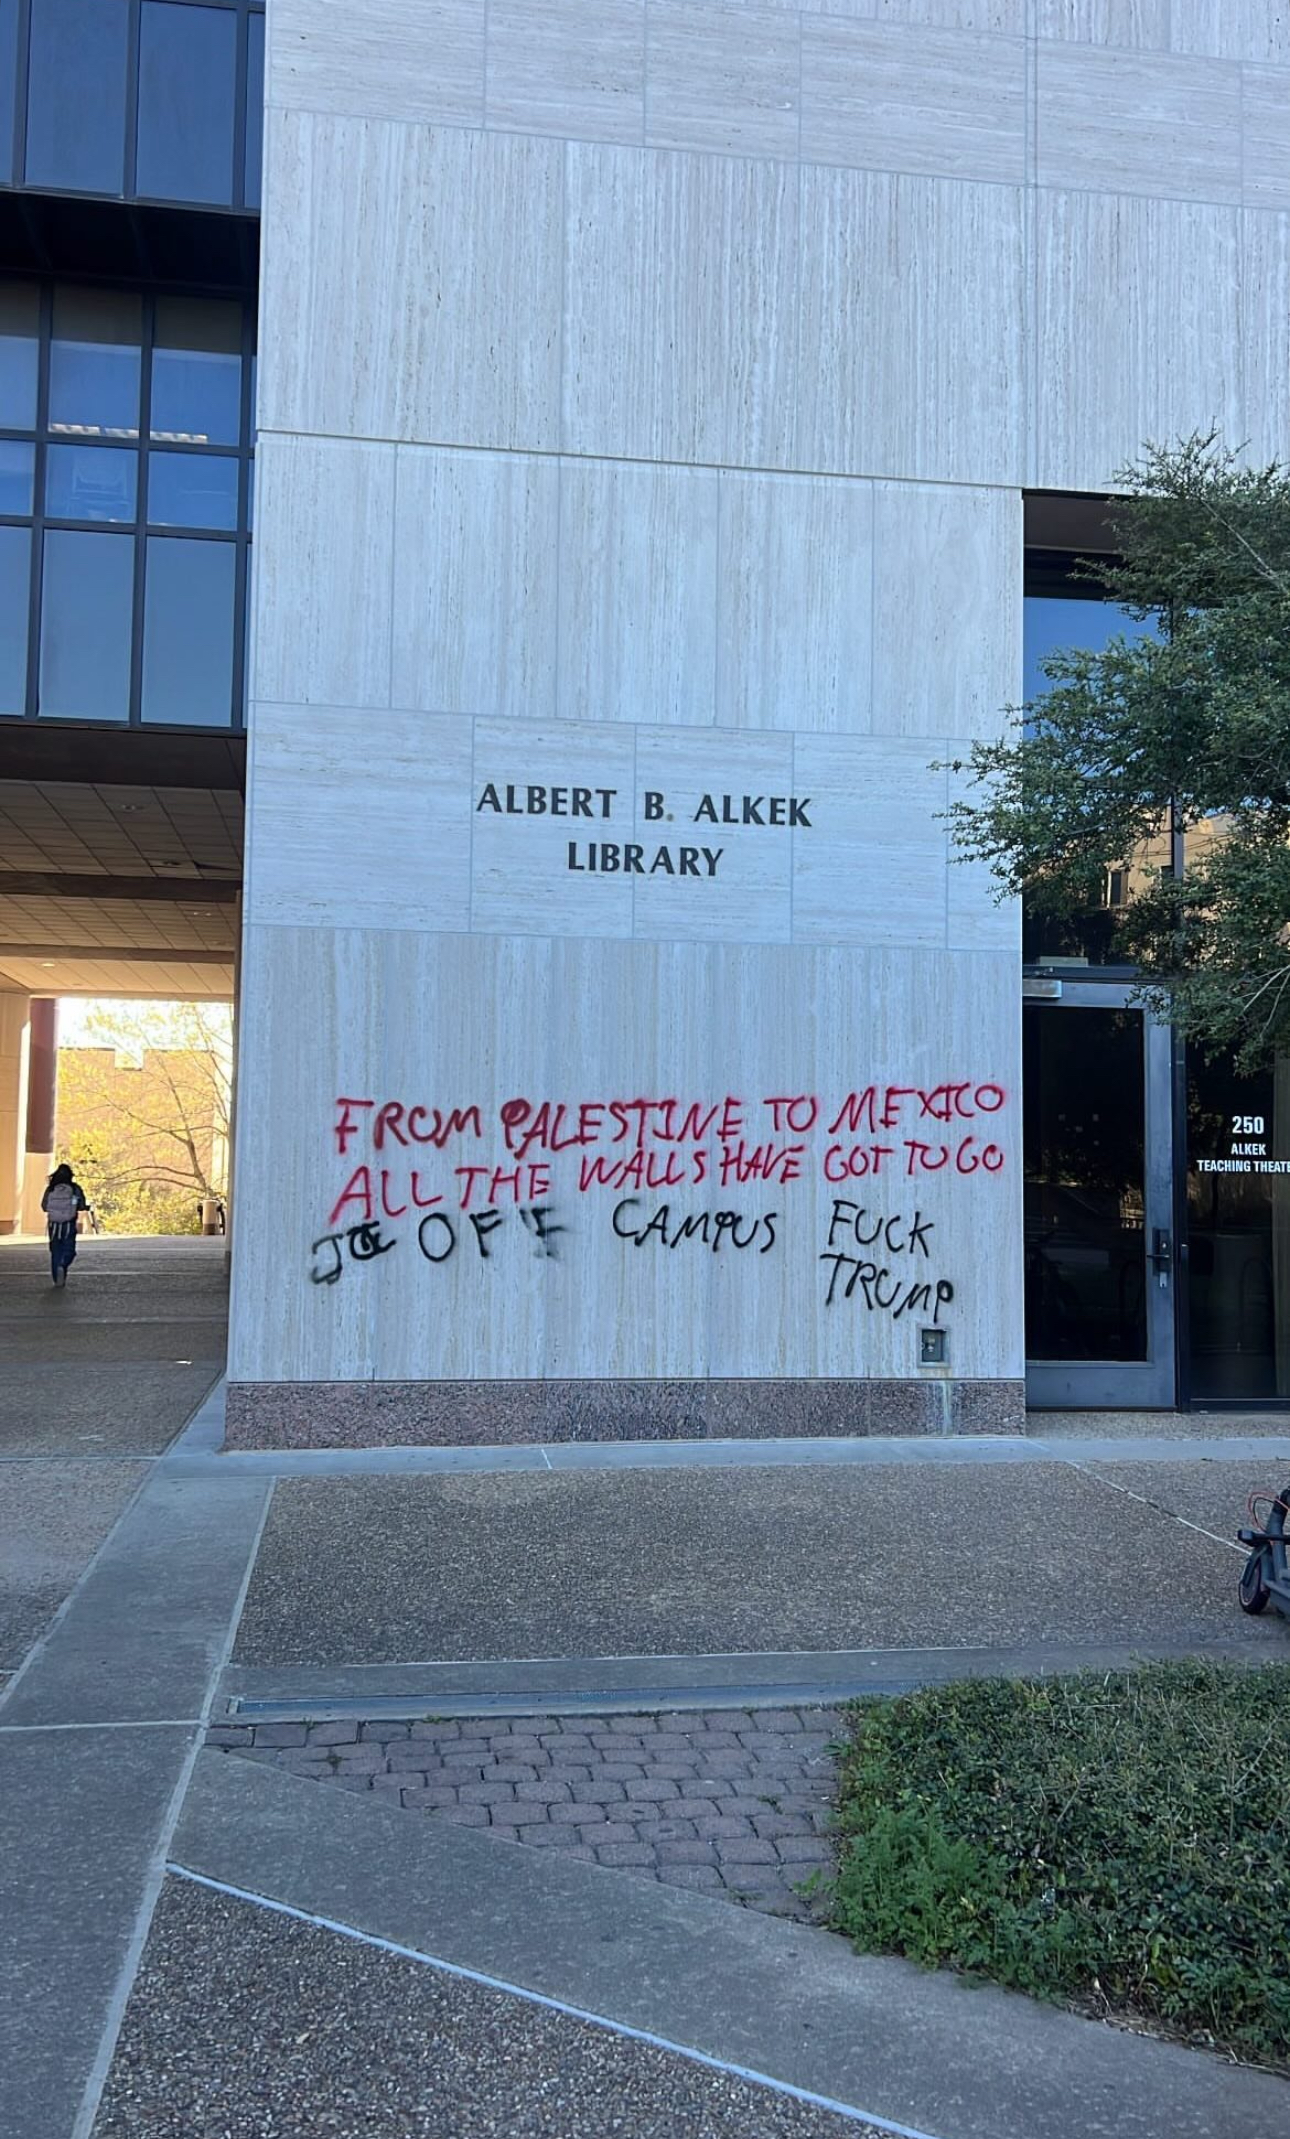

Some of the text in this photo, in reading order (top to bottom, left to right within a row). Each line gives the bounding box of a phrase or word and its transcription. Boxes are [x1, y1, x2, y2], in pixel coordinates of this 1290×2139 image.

[476, 783, 813, 827] ALBERT B. ALKEK
[567, 841, 724, 877] LIBRARY
[335, 1082, 1004, 1160] FROM PALESTINE TO MEXICO
[1231, 1115, 1265, 1135] 250
[1196, 1159, 1251, 1172] TEACHING
[1230, 1142, 1267, 1156] ALKEK
[328, 1135, 1004, 1226] ALL THE WALLS HAVE GOT TO GO
[418, 1206, 566, 1263] OFF
[612, 1198, 778, 1253] CAMPUS
[828, 1199, 935, 1259] FUCK
[819, 1252, 954, 1325] TRUMP
